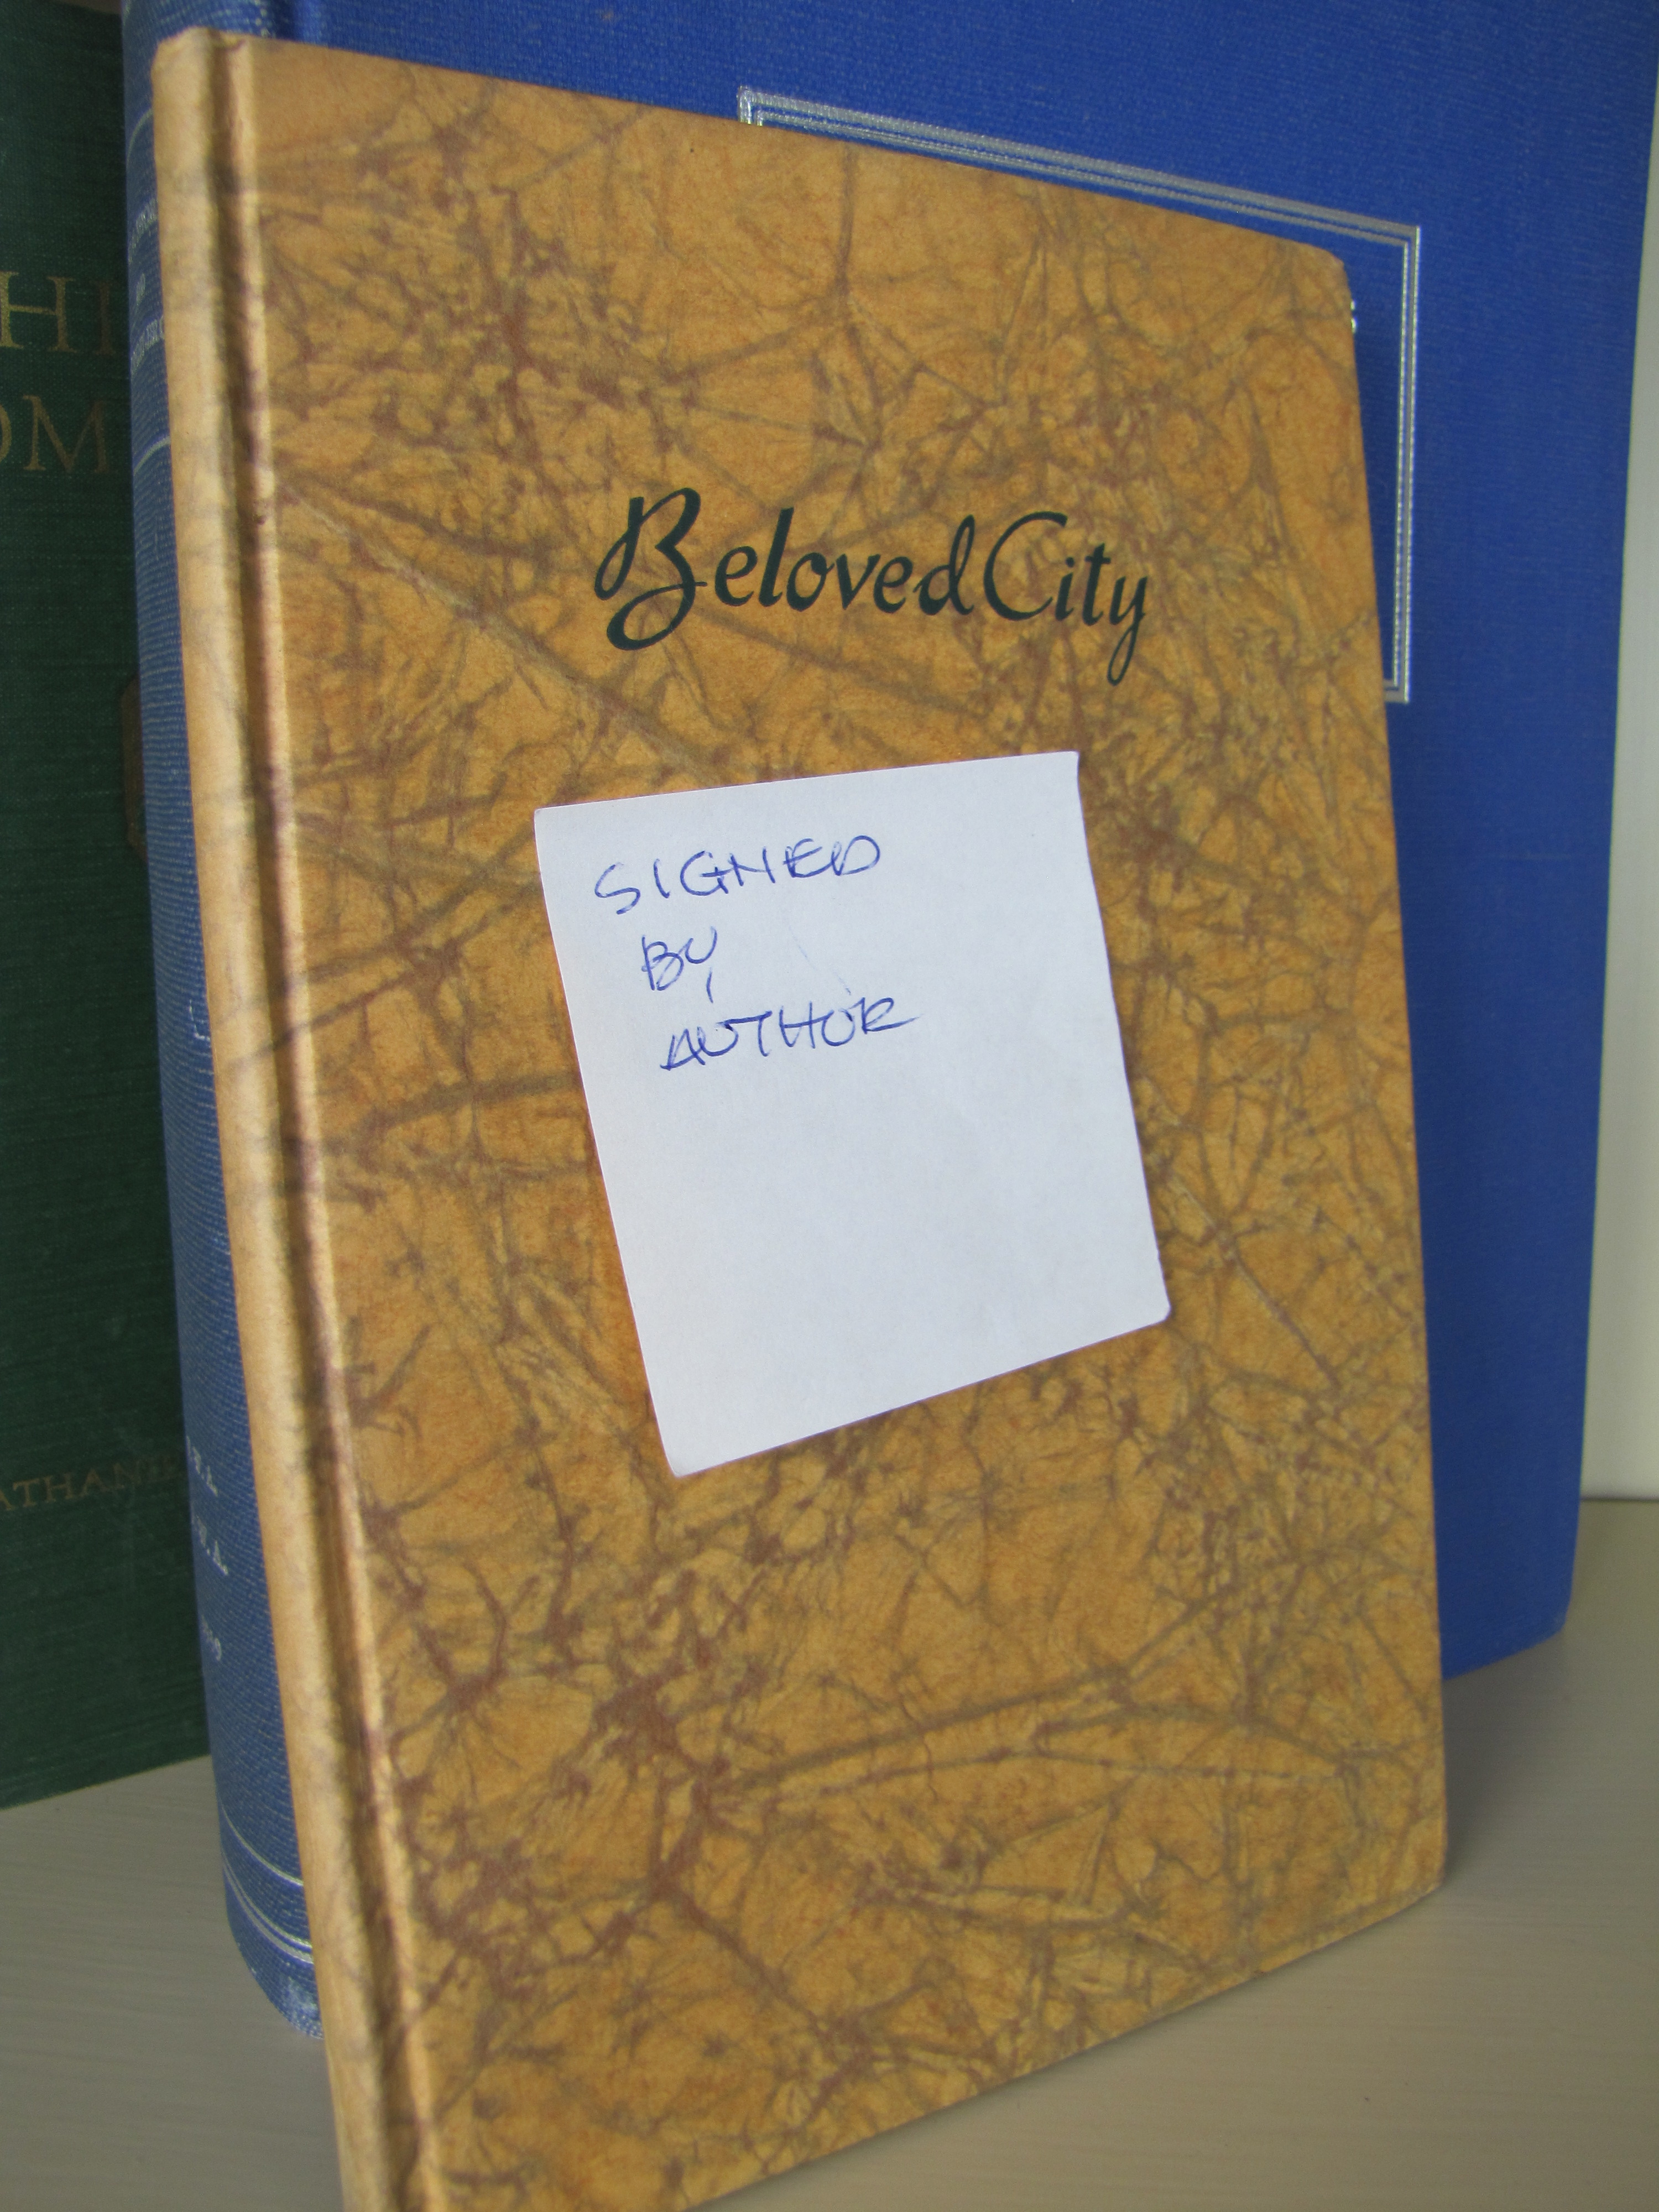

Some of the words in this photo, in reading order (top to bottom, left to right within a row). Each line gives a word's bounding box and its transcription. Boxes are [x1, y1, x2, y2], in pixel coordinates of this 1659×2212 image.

[0, 394, 111, 474] M
[594, 487, 975, 650] Beloved
[984, 511, 1147, 686] City
[593, 834, 881, 915] SIGNED
[640, 926, 718, 1003] BY
[660, 997, 918, 1071] AUTHOR
